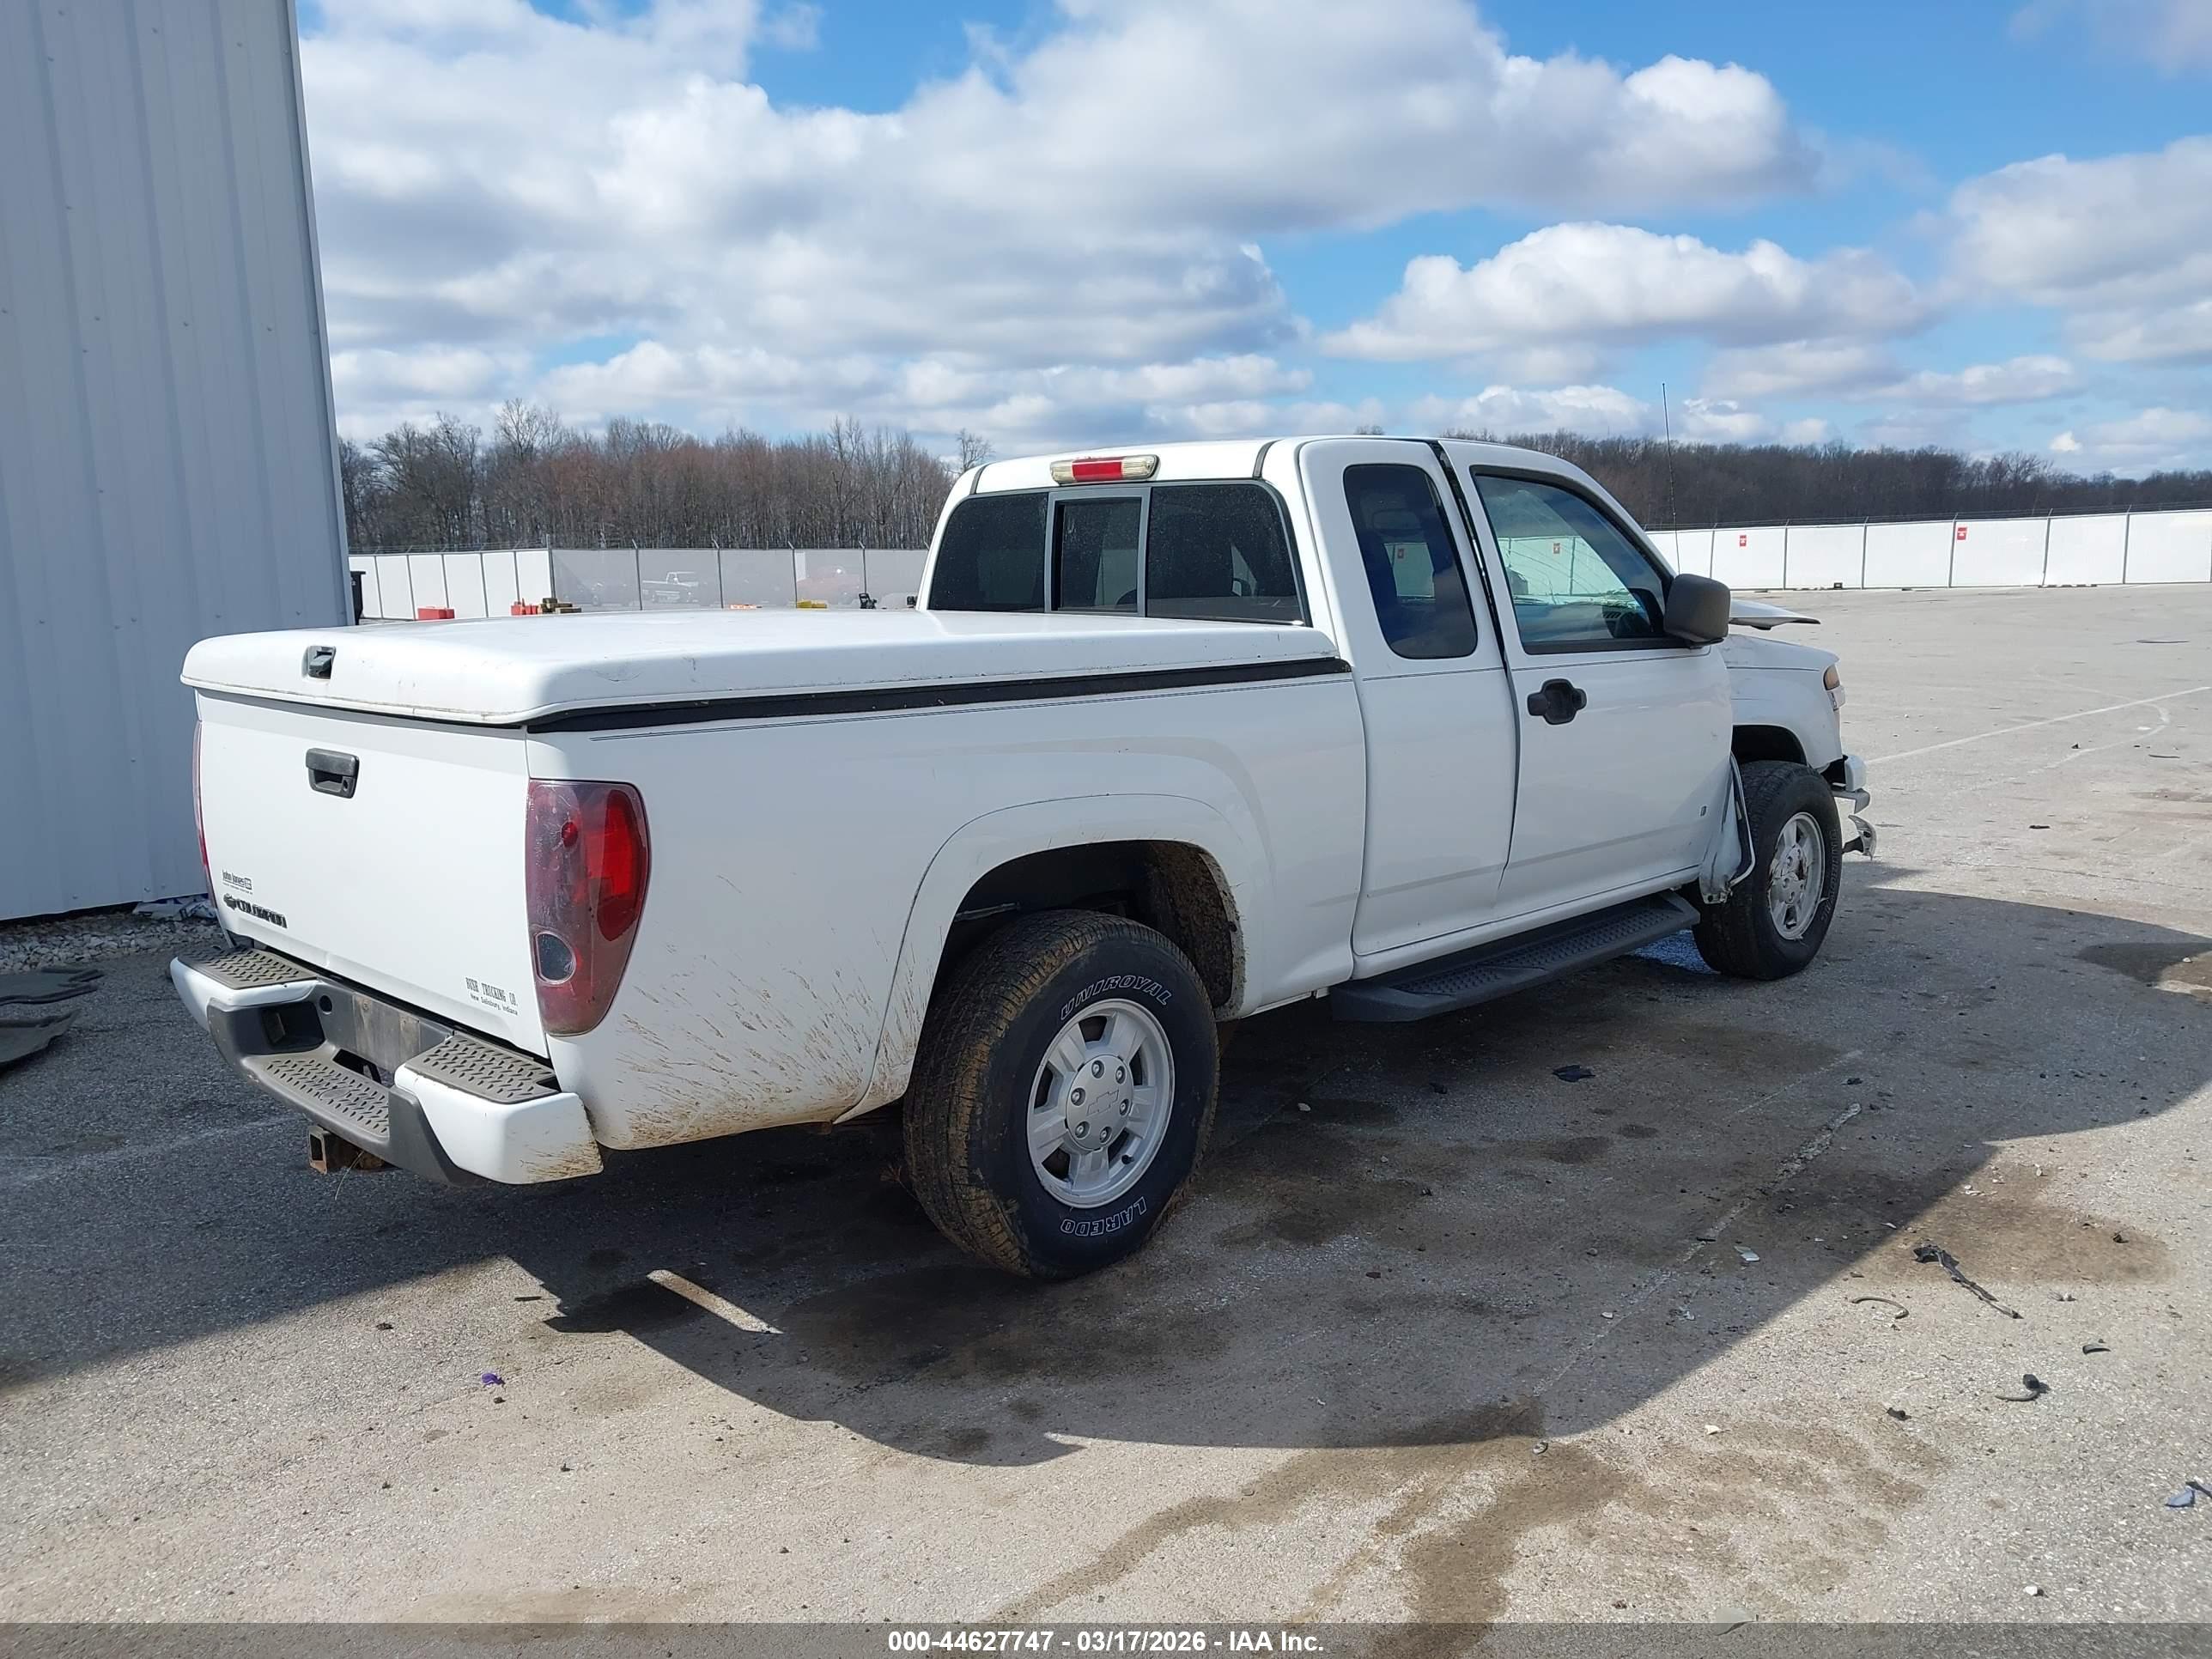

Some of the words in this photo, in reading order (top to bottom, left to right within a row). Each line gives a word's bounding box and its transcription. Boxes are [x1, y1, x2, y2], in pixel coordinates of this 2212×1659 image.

[481, 982, 506, 1002] TRUCKING
[1060, 975, 1172, 1021] UNIROYAL
[1060, 1195, 1147, 1237] LAREDO
